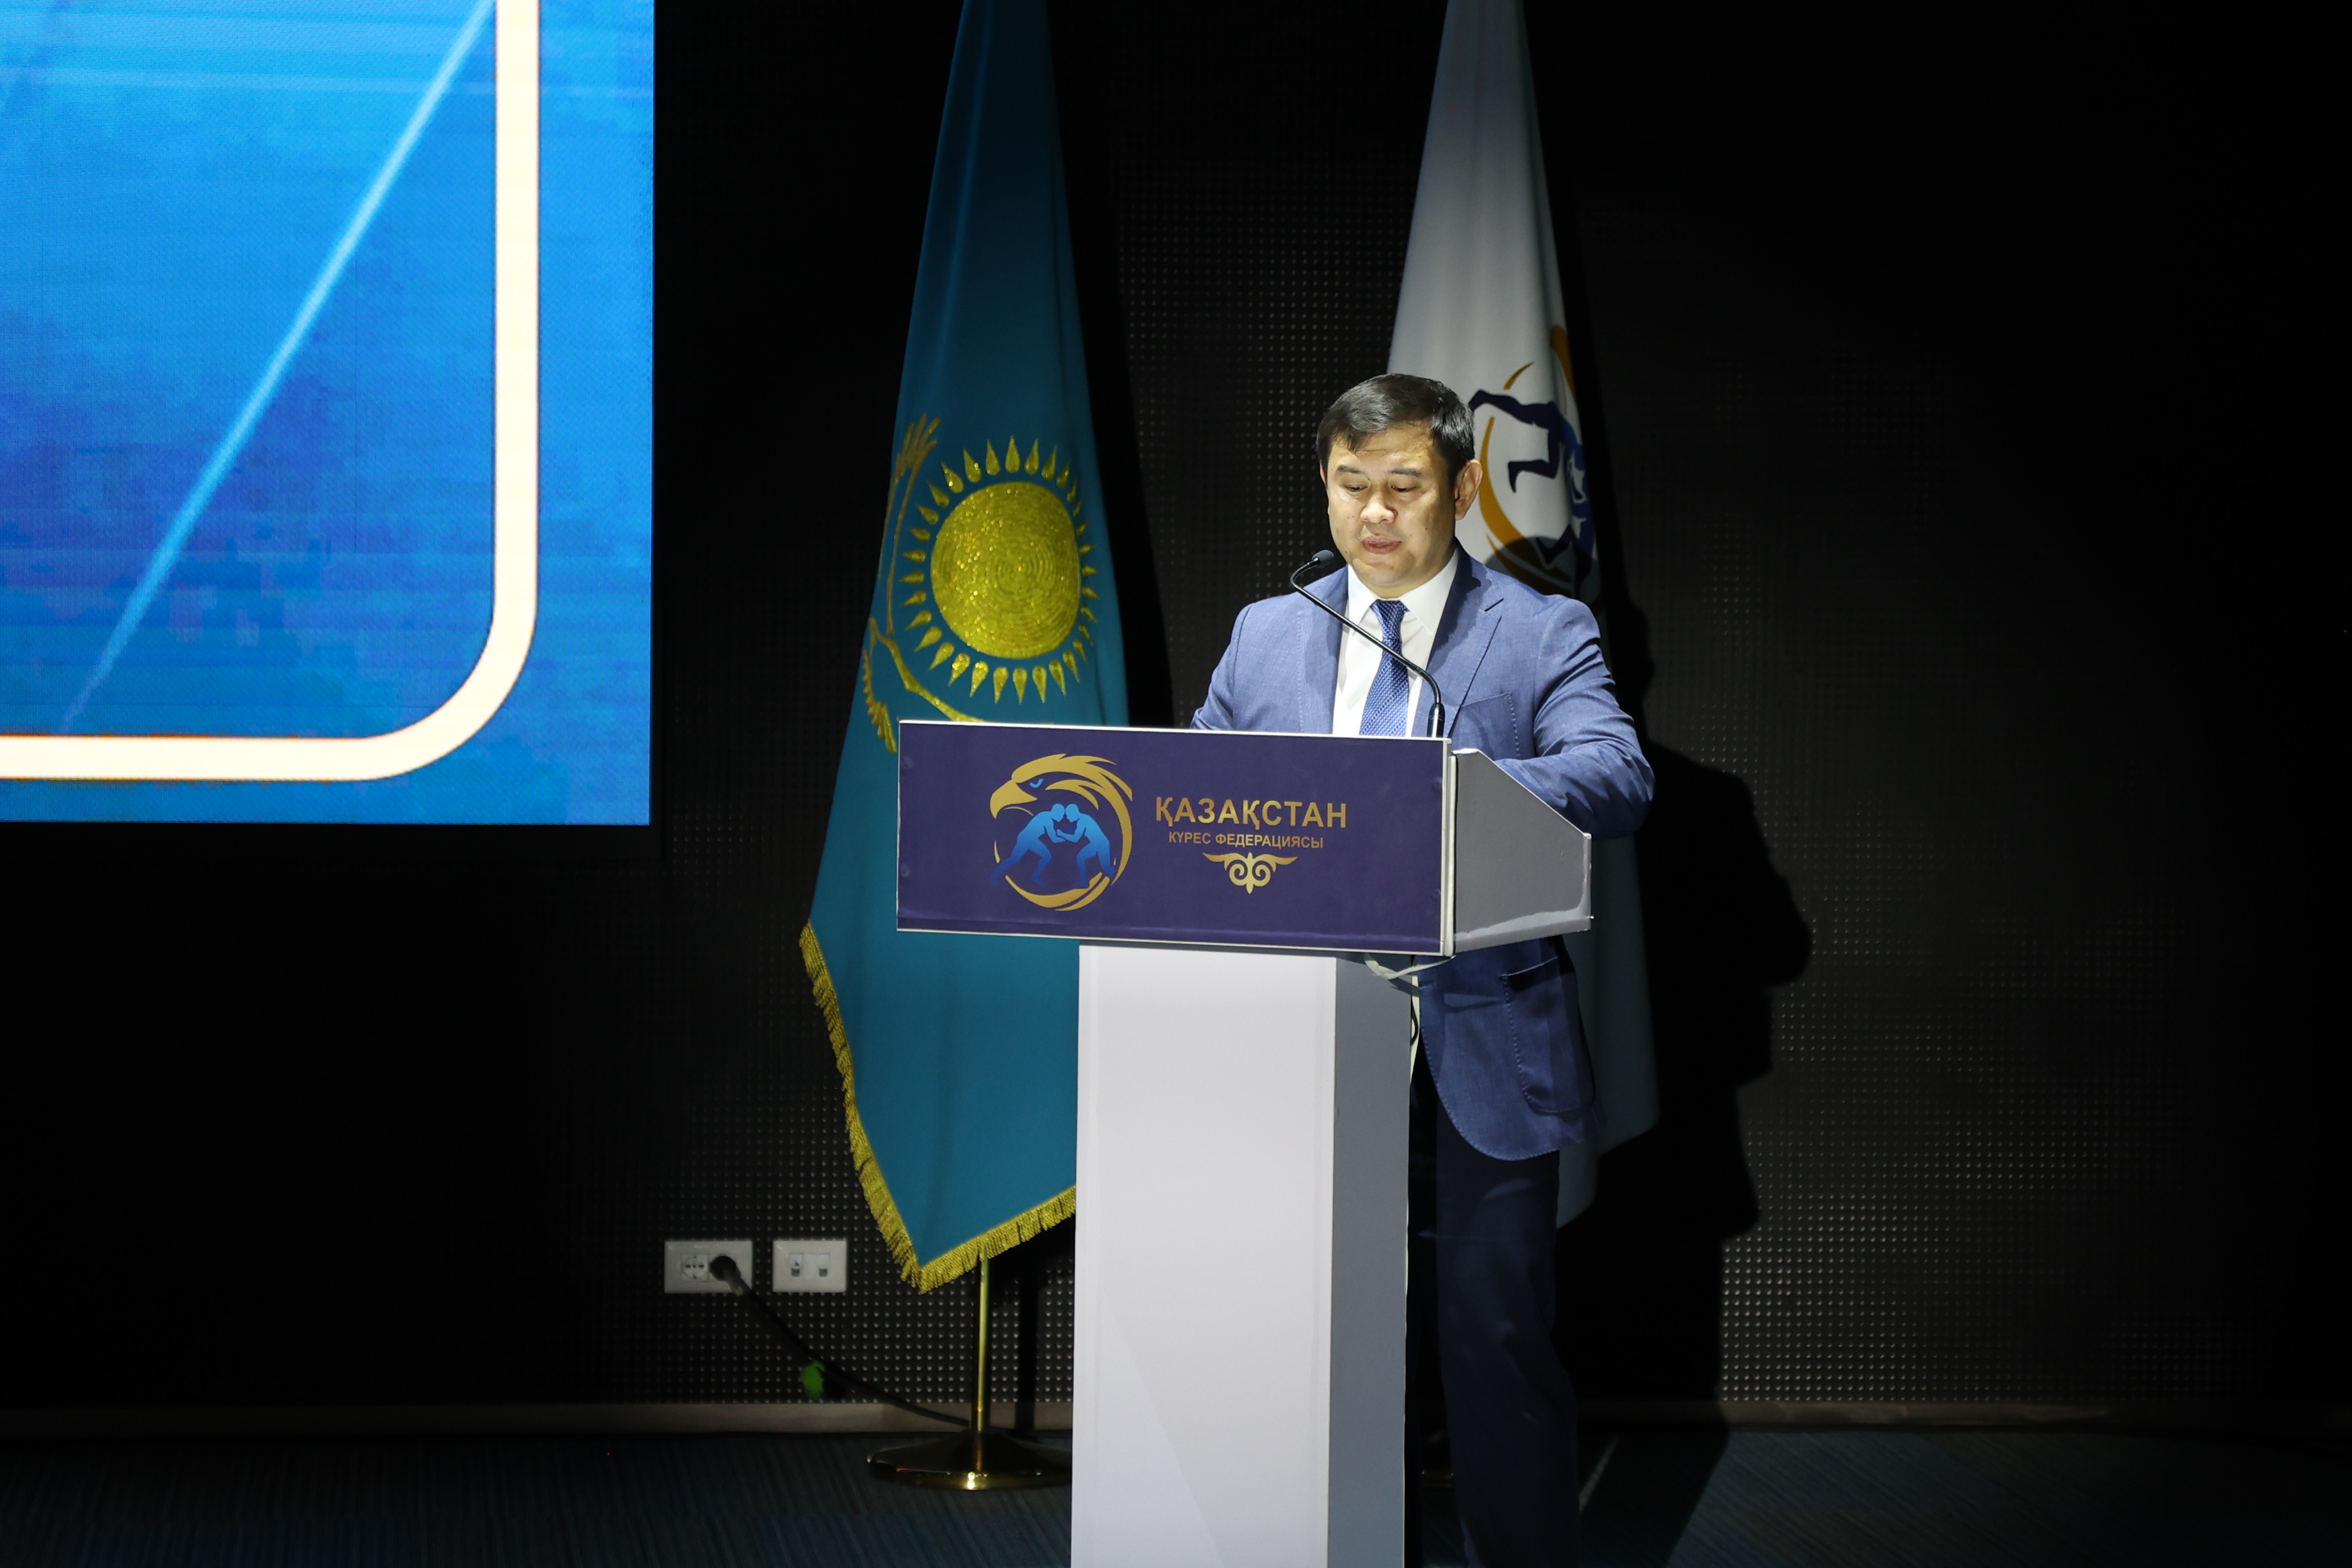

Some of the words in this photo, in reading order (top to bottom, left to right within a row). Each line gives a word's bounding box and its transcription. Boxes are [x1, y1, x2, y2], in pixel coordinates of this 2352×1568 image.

[1156, 797, 1346, 830] ҚАЗАҚСТАН
[1168, 831, 1211, 844] КҮРЕС
[1216, 834, 1324, 849] ФЕДЕРАЦИЯСЫ
